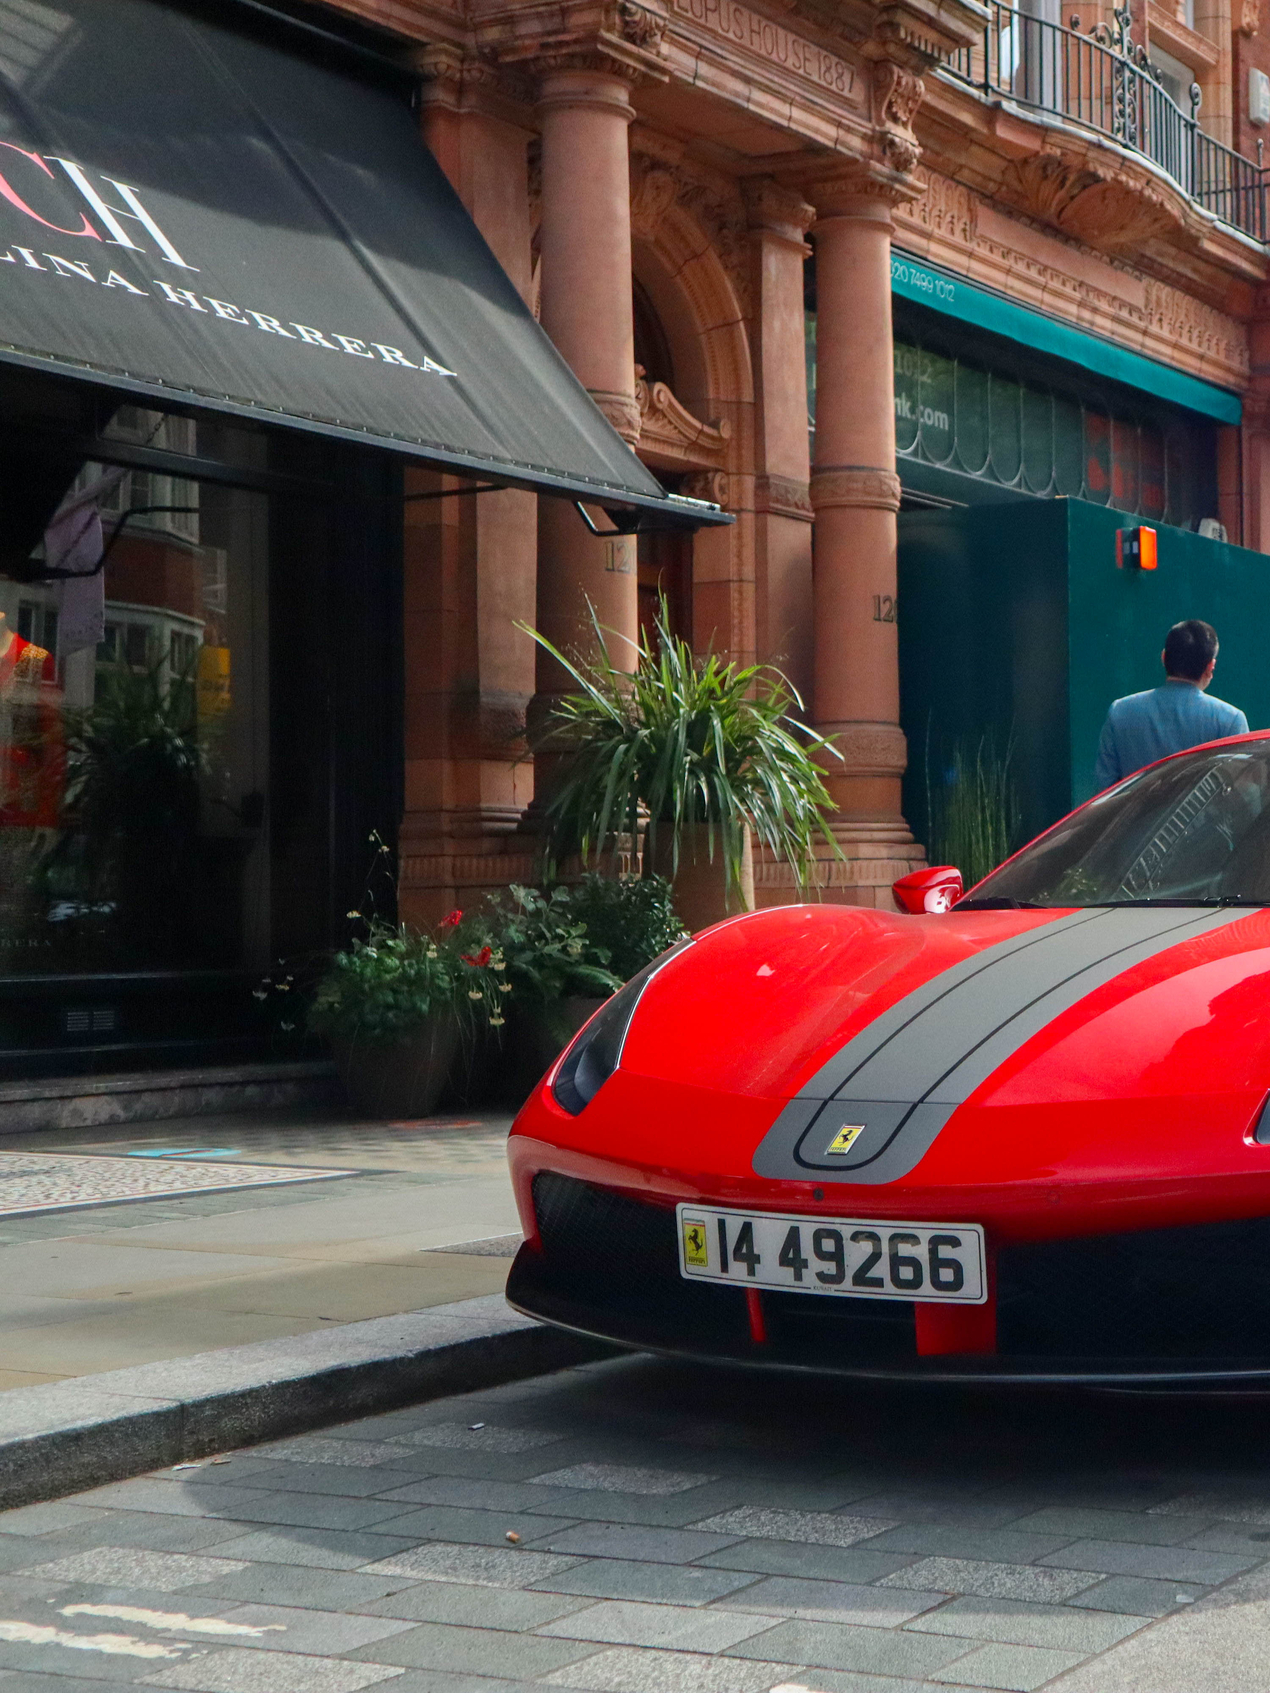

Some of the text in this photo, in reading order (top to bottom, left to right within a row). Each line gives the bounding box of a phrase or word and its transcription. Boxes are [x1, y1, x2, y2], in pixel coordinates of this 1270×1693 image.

[750, 19, 812, 76] HOUSE
[817, 50, 856, 93] 1887
[0, 244, 457, 377] INA HERRERA
[909, 268, 934, 293] 7499
[935, 280, 955, 302] 1012
[717, 1218, 964, 1292] 14 49266
